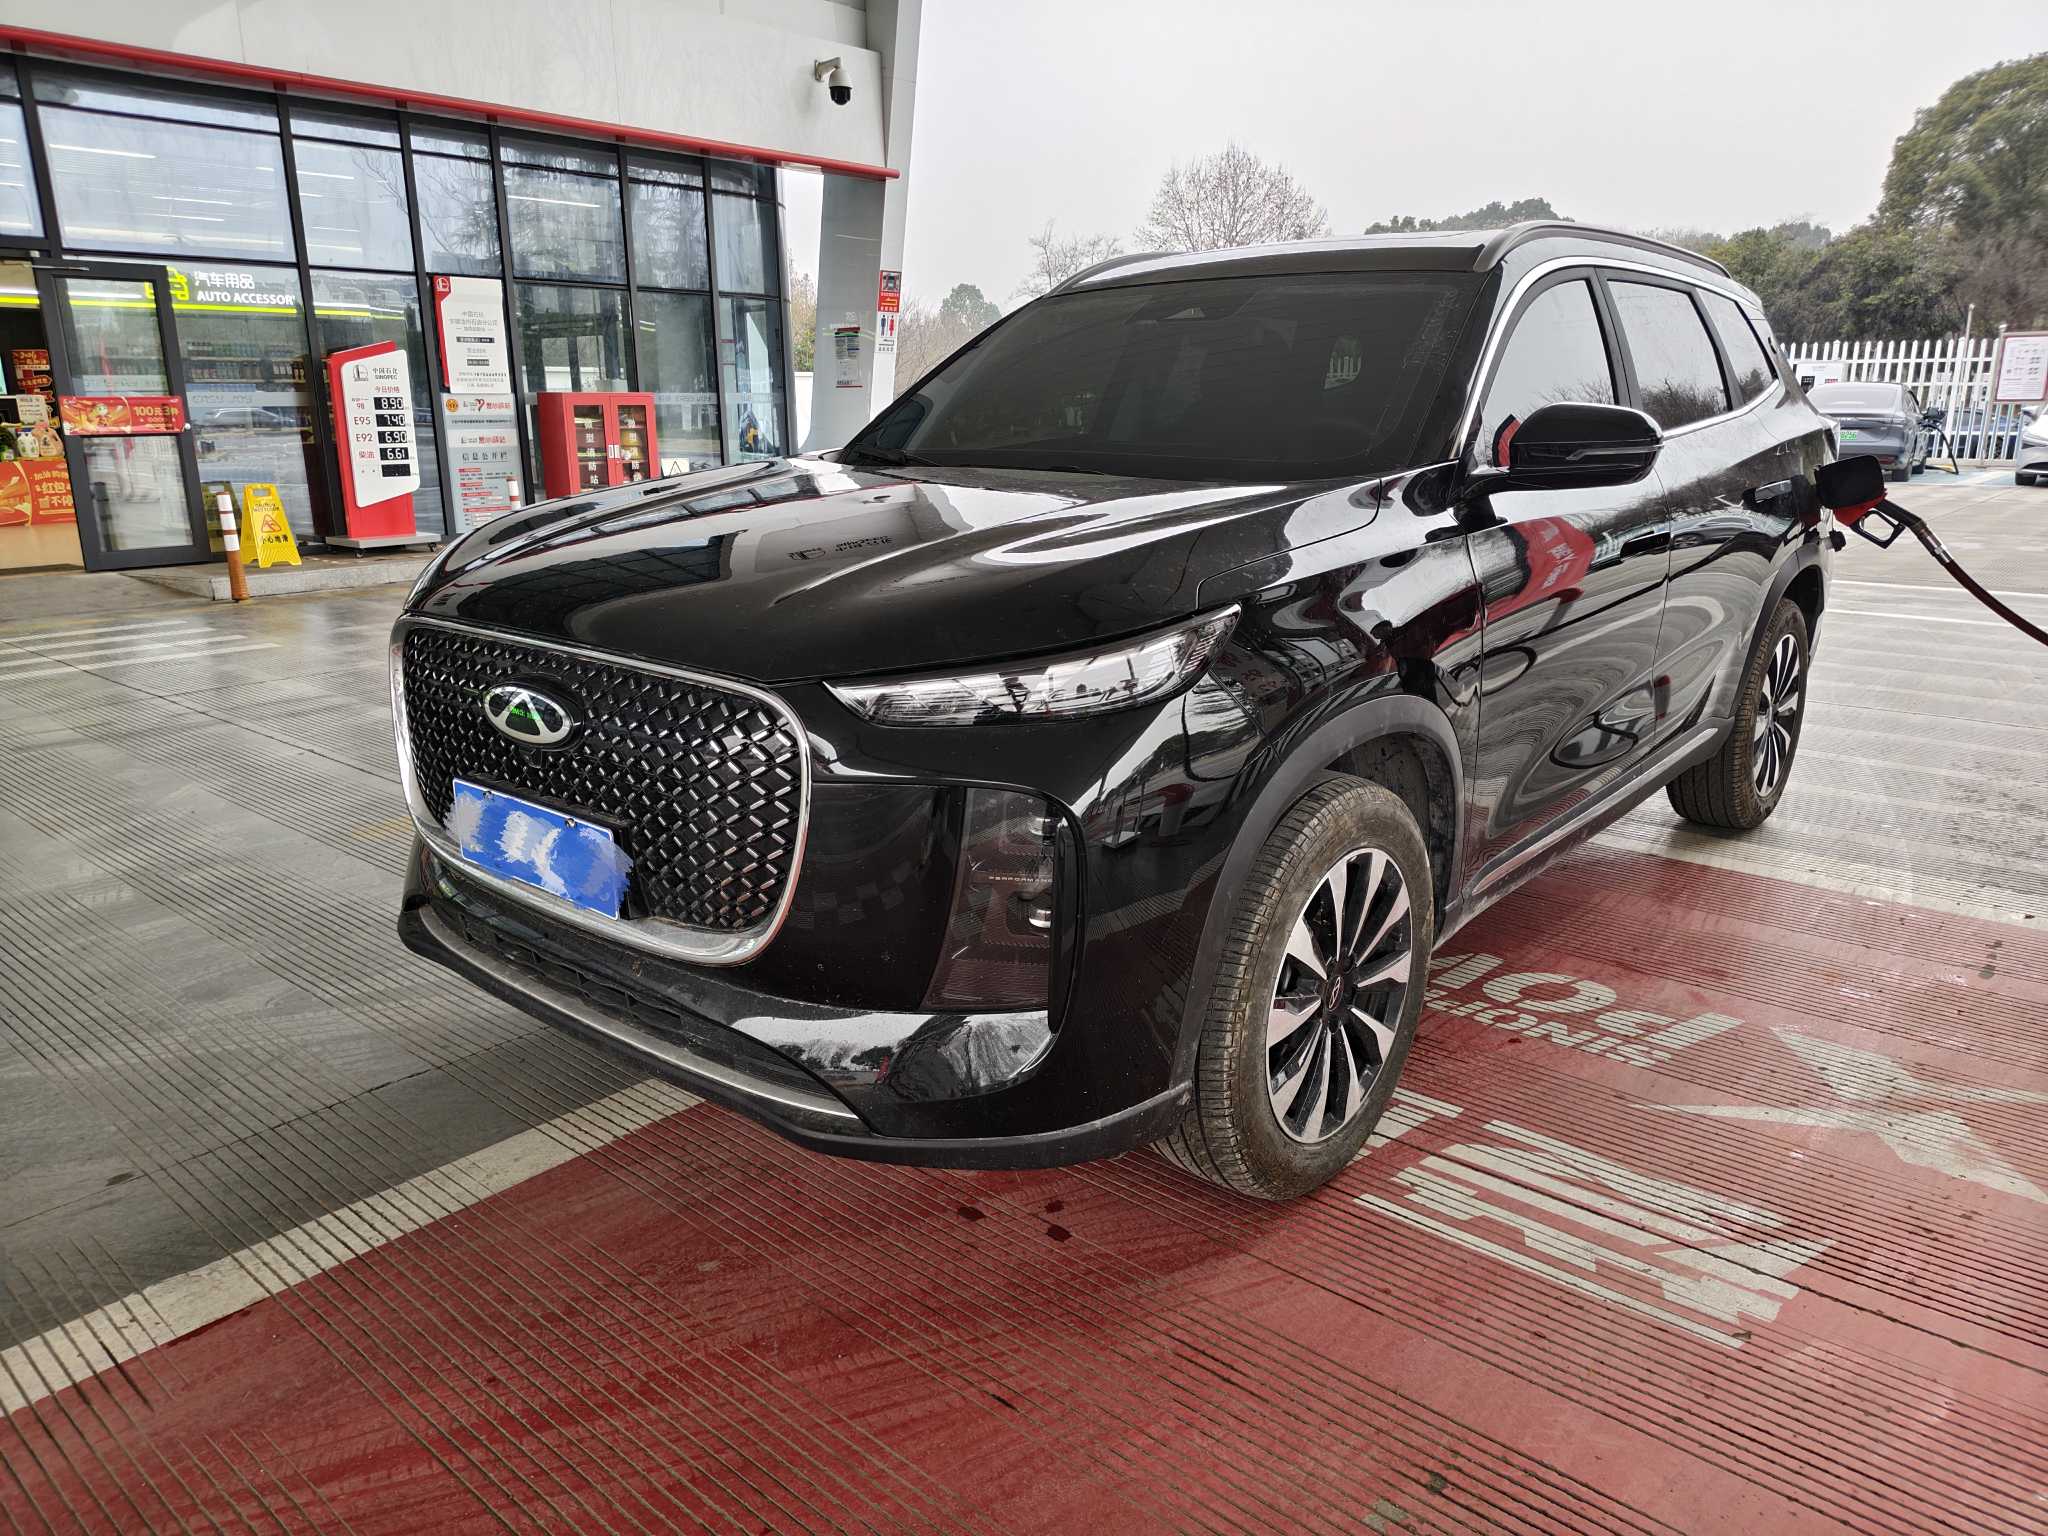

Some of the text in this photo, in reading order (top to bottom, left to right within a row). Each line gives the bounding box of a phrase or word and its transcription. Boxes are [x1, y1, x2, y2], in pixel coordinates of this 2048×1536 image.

[194, 271, 255, 289] 汽车用品
[197, 291, 296, 306] AUTO ACCESSOR
[381, 398, 404, 409] 8.90
[353, 414, 405, 426] E95 7.40
[355, 431, 407, 443] E92 6.90
[387, 448, 405, 460] 6.61
